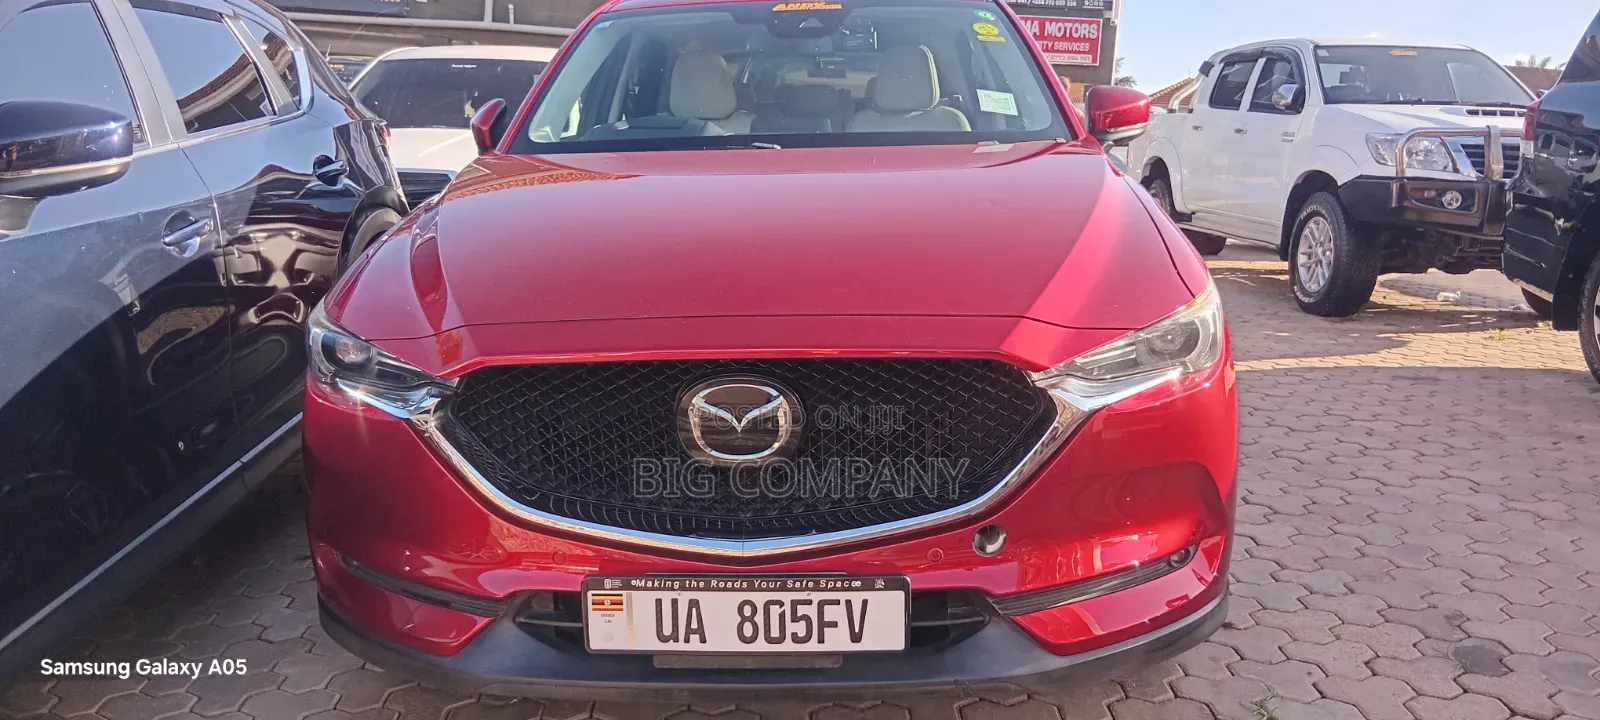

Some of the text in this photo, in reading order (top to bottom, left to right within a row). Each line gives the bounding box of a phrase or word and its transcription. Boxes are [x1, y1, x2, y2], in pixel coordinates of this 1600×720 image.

[1044, 22, 1098, 39] MOTORS
[1054, 42, 1090, 52] SERVICES
[635, 579, 681, 590] Making
[685, 579, 705, 588] the
[710, 579, 748, 589] Roads
[754, 579, 781, 589] Your
[786, 579, 814, 589] Safe
[654, 597, 869, 646] UA 805FV
